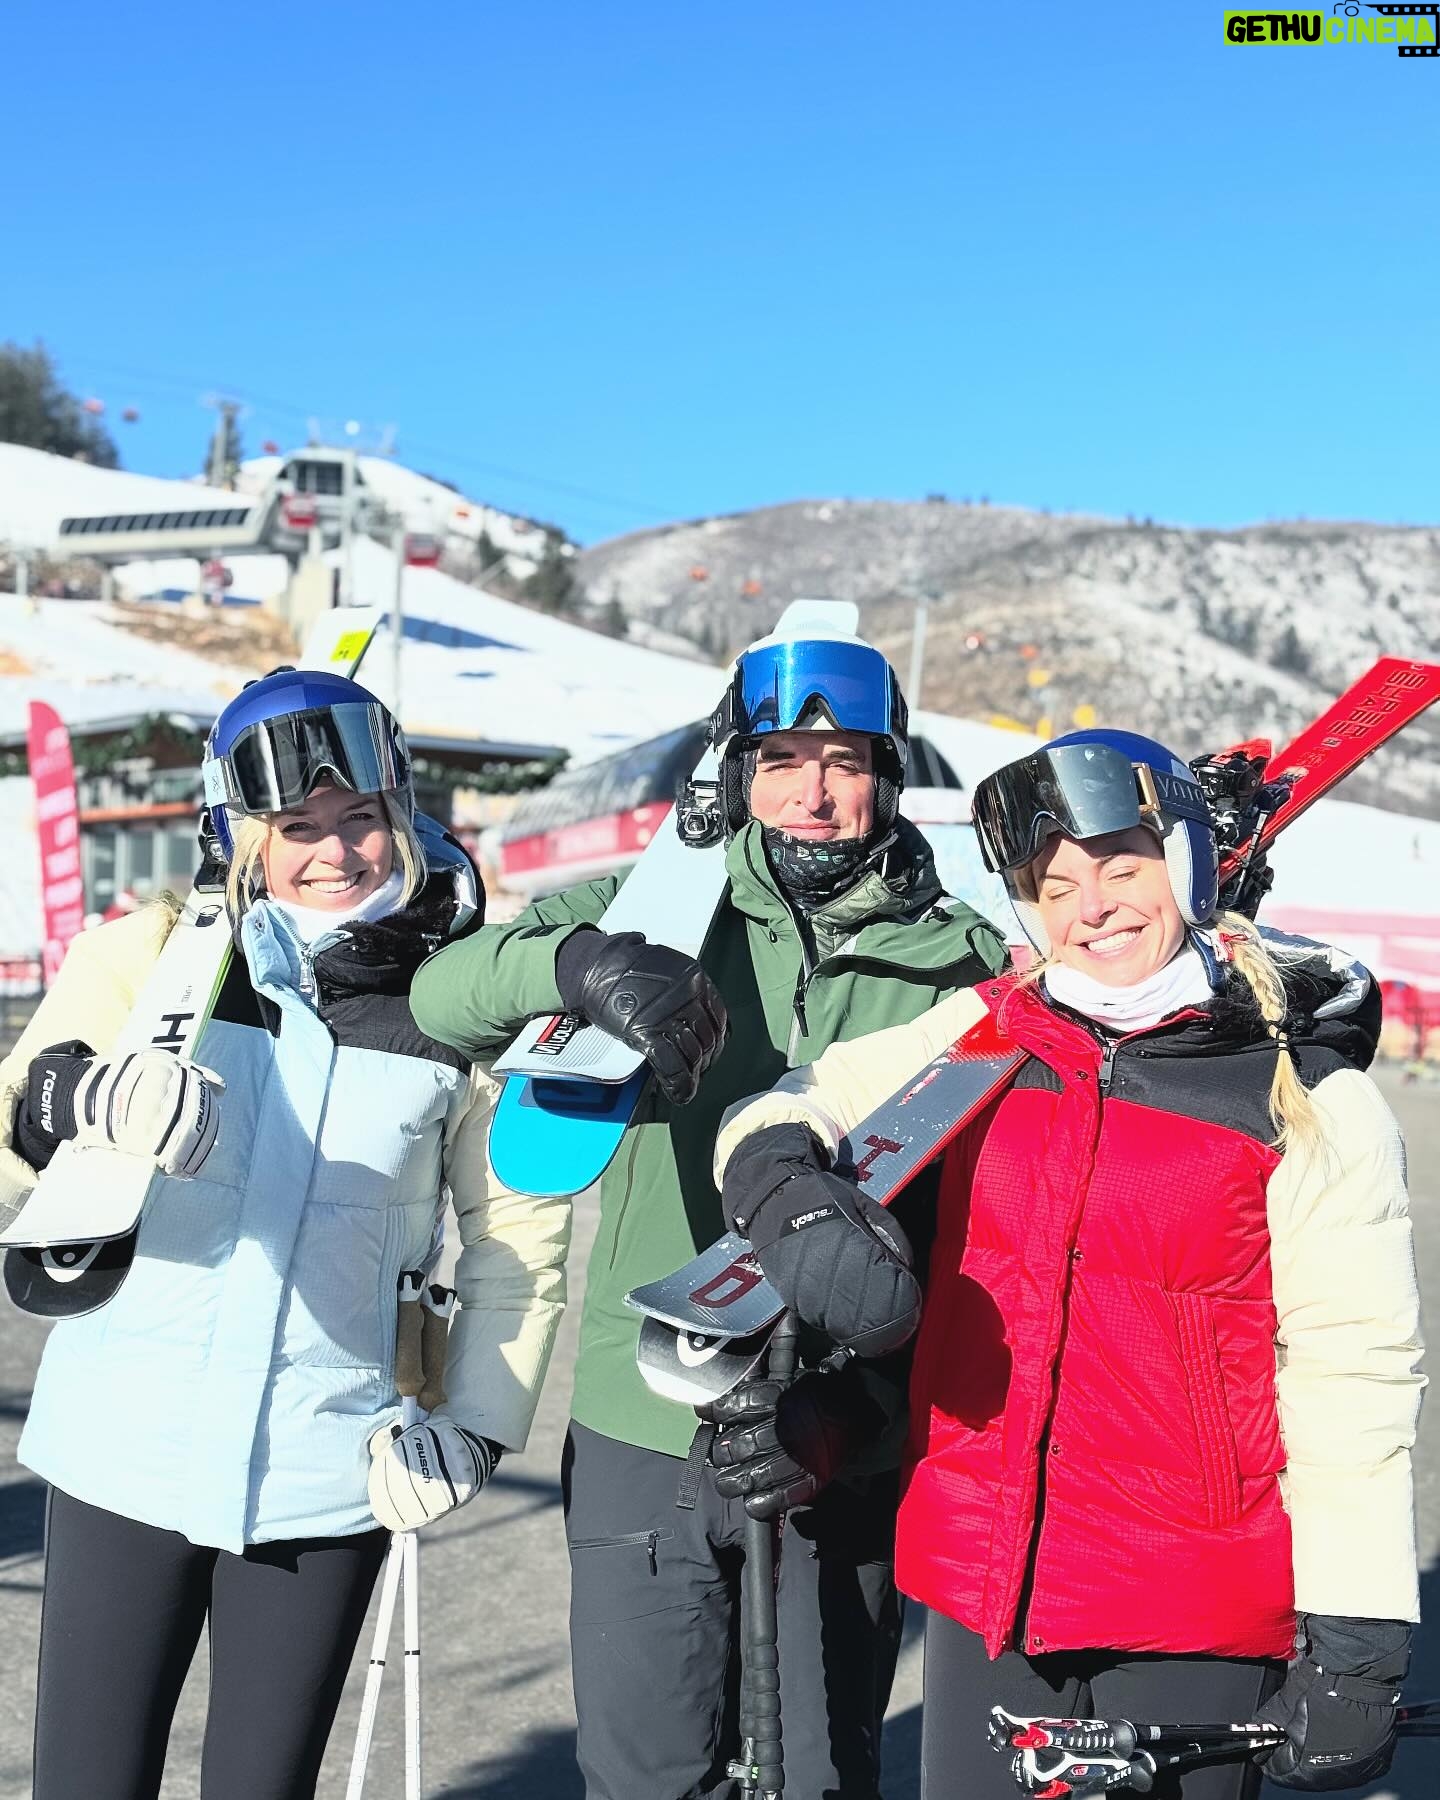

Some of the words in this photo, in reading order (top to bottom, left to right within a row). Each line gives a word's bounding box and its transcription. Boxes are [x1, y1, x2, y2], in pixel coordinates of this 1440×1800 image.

[413, 1437, 433, 1484] reusch
[1083, 1722, 1109, 1733] LEKI
[1106, 1766, 1132, 1785] LEKI
